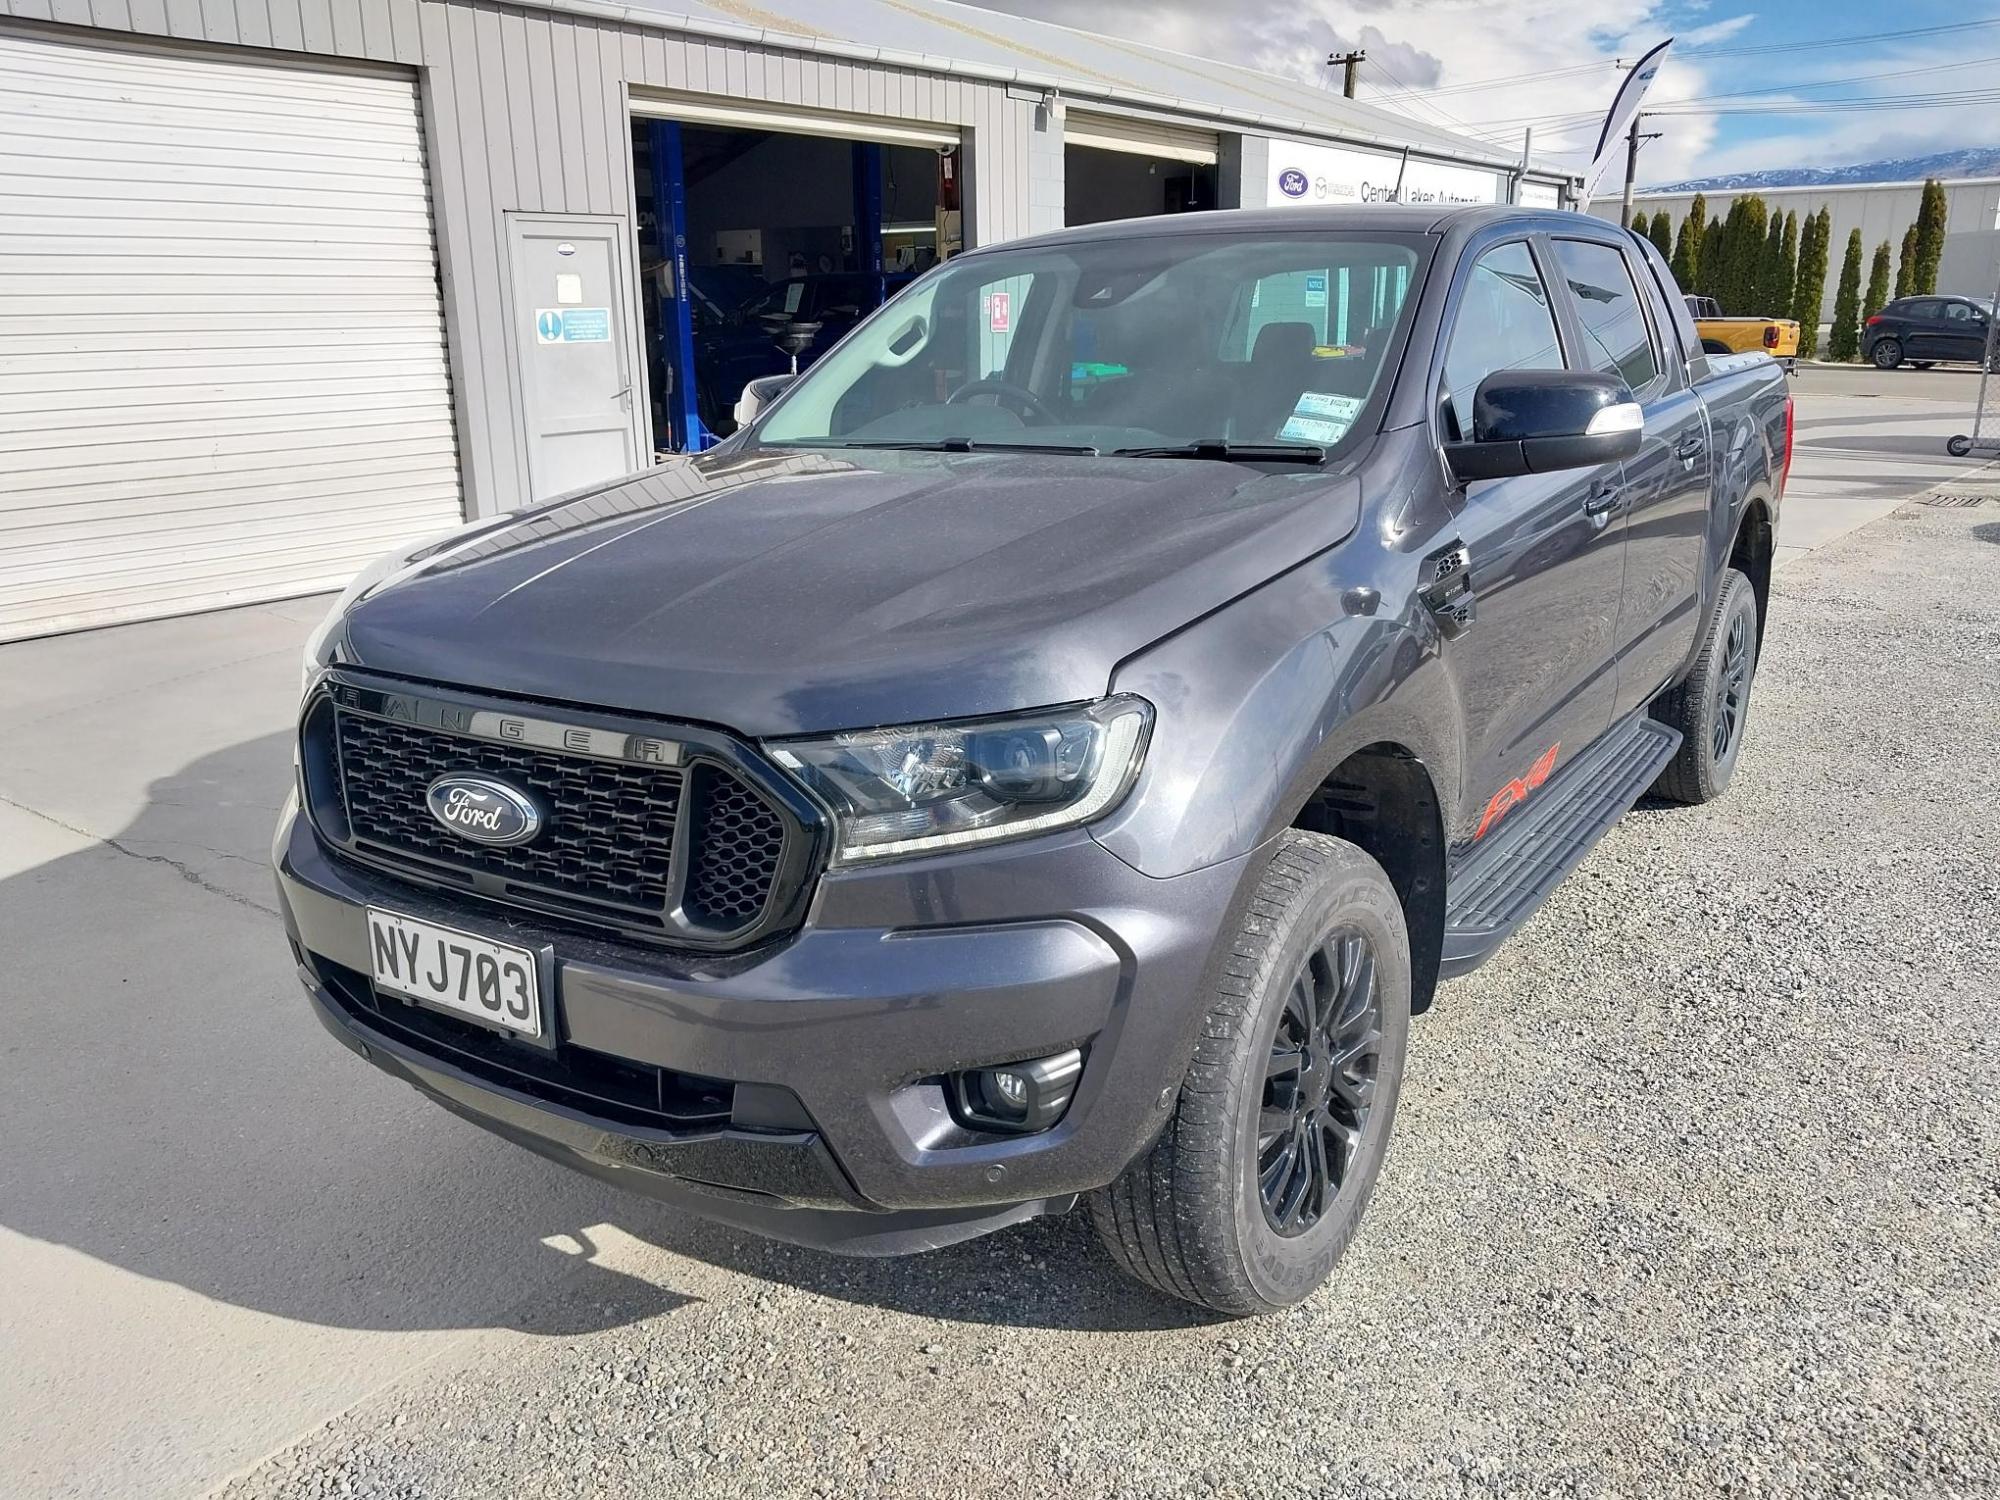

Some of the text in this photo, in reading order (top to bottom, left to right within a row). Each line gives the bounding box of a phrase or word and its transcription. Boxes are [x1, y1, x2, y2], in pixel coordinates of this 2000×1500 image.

[1361, 181, 1402, 202] Centrl
[341, 689, 666, 763] RANGER
[443, 787, 502, 832] Ford
[1473, 740, 1561, 841] FX4
[373, 921, 530, 1021] NYJ703
